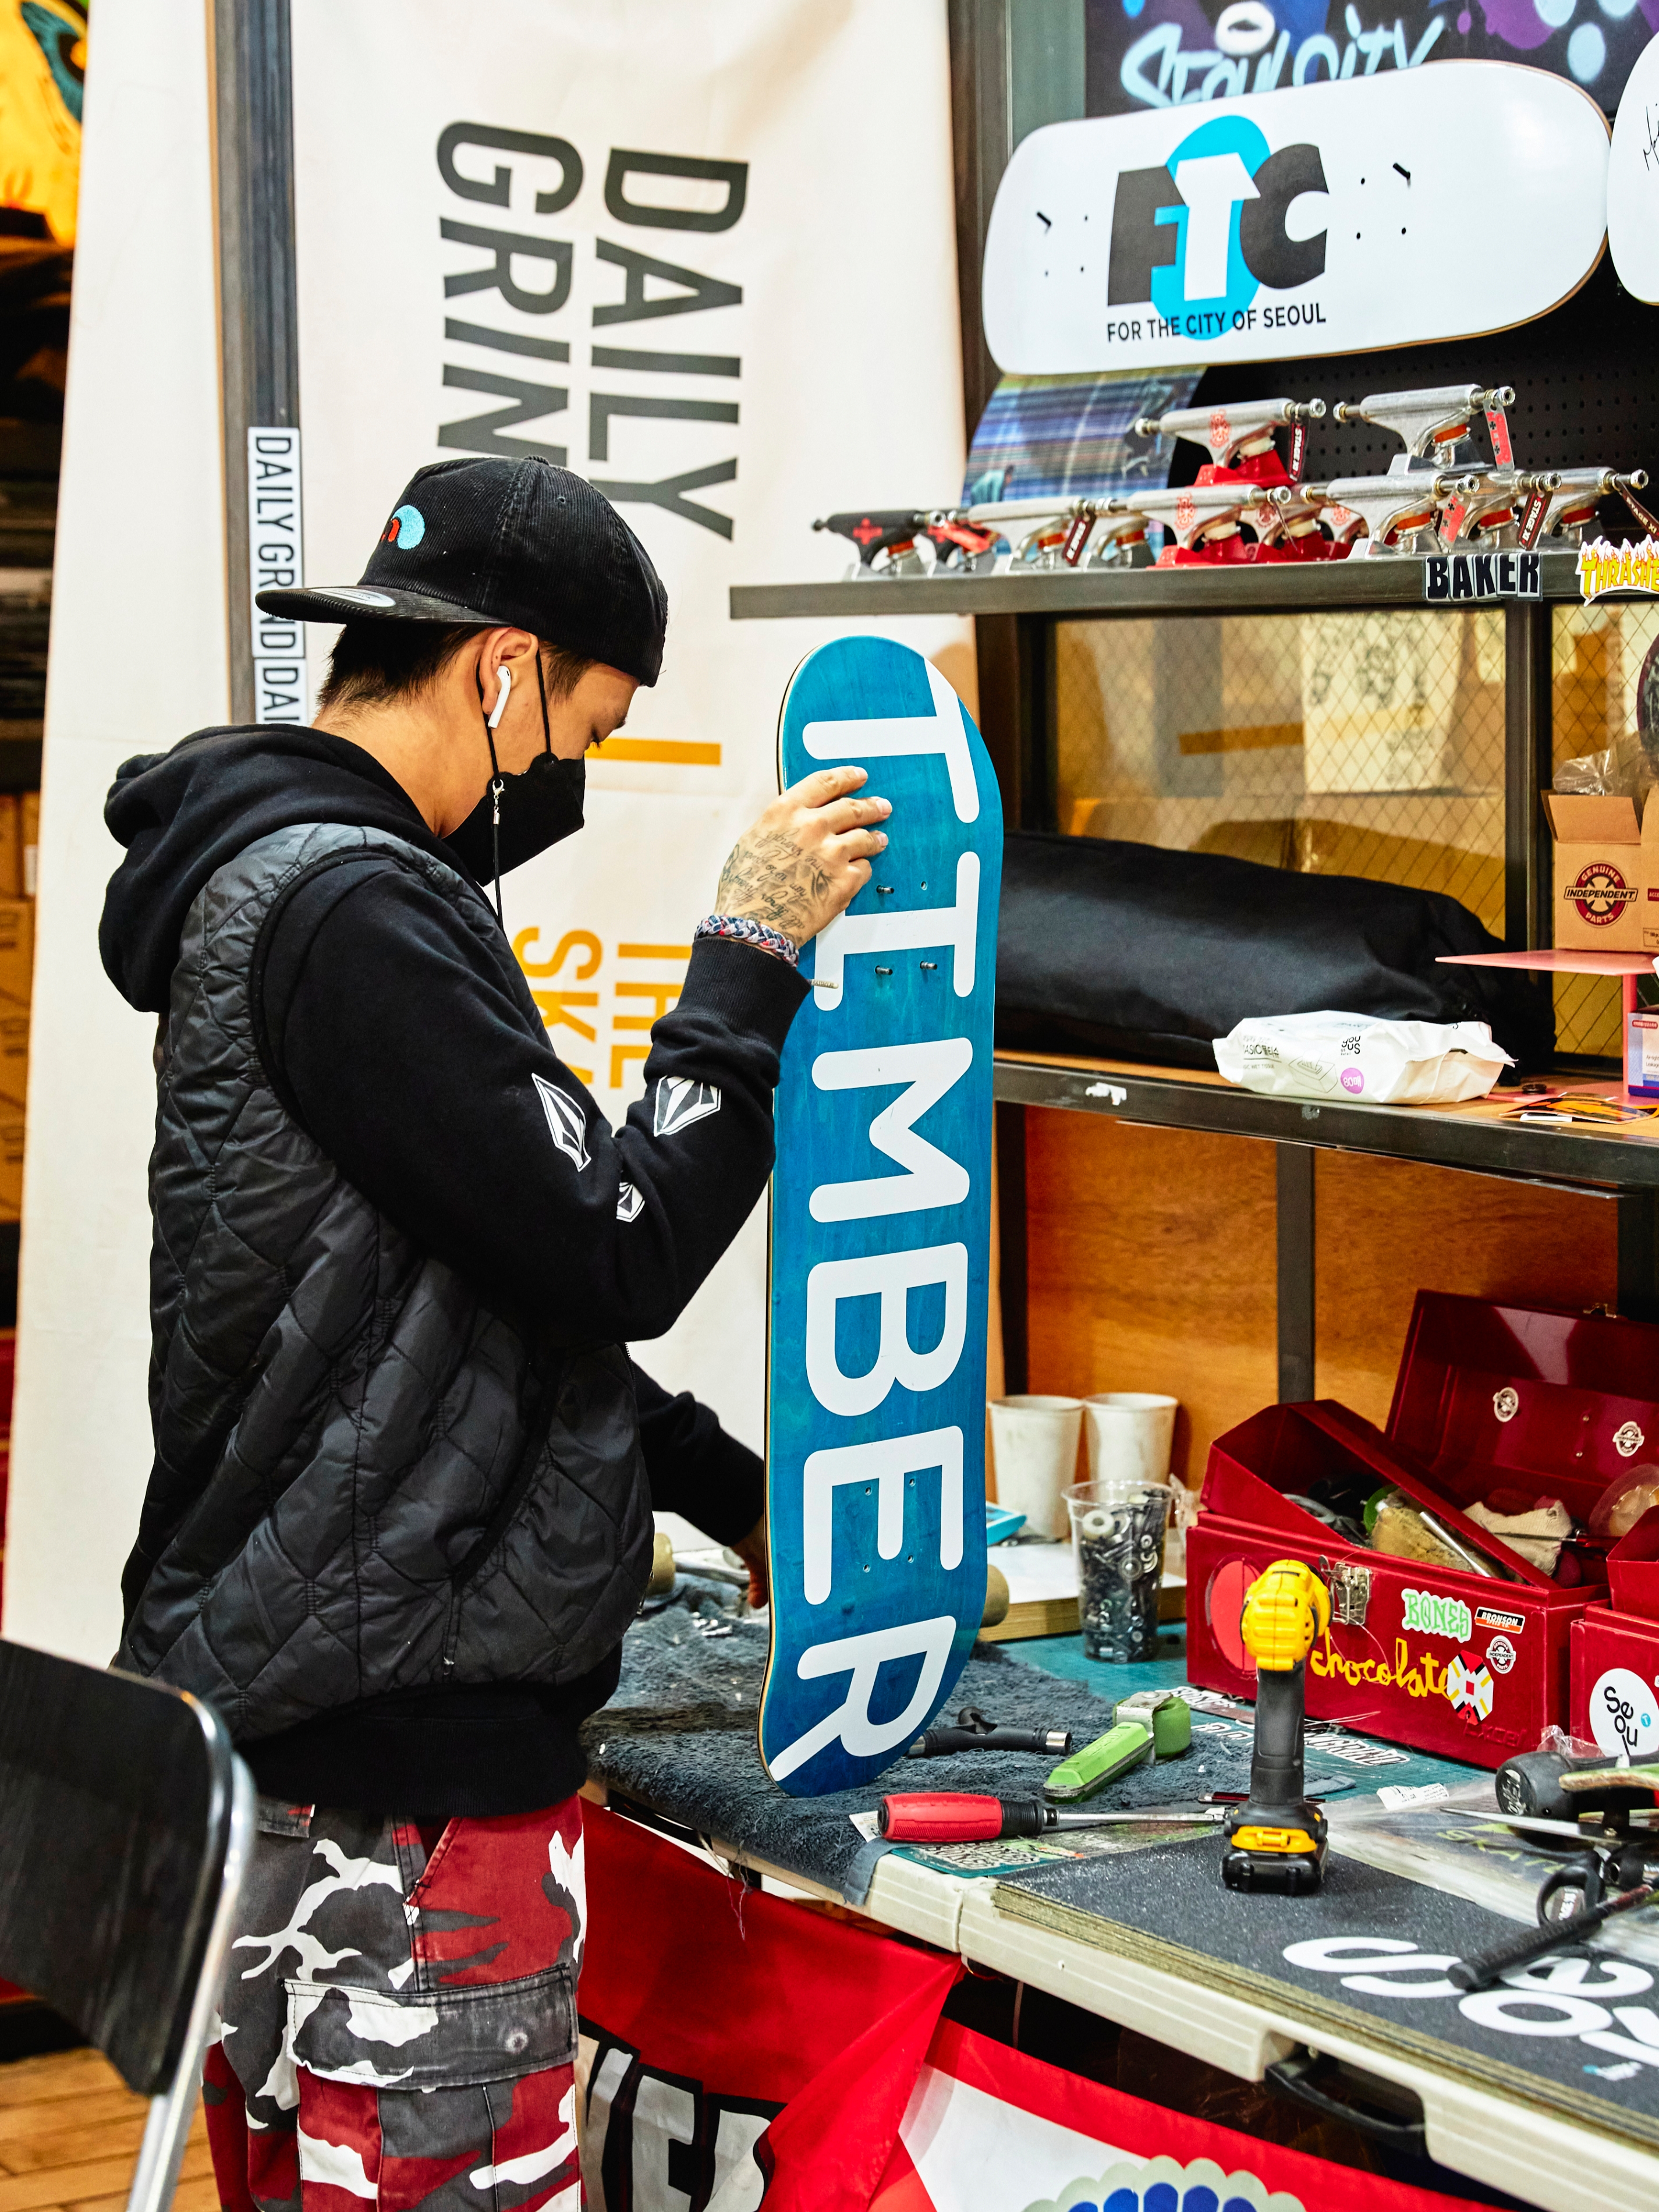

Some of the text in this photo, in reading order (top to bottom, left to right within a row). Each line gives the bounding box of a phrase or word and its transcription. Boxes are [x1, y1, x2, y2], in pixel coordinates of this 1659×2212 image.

[1107, 143, 1330, 307] FTC
[435, 120, 584, 467] GRIN
[588, 147, 750, 541] DAILY
[1108, 303, 1326, 343] FOR THE CITY OF SEOUL
[255, 435, 293, 533] DAILY
[1526, 499, 1543, 532] STAGE
[1427, 554, 1539, 600] BAKER
[1566, 889, 1635, 900] INDEPENDENT
[1581, 865, 1621, 883] GENUINE
[1585, 912, 1614, 924] PARTS
[770, 657, 980, 1784] TIMBER
[1405, 1593, 1469, 1638] BONES
[1481, 1611, 1519, 1626] BRONSON
